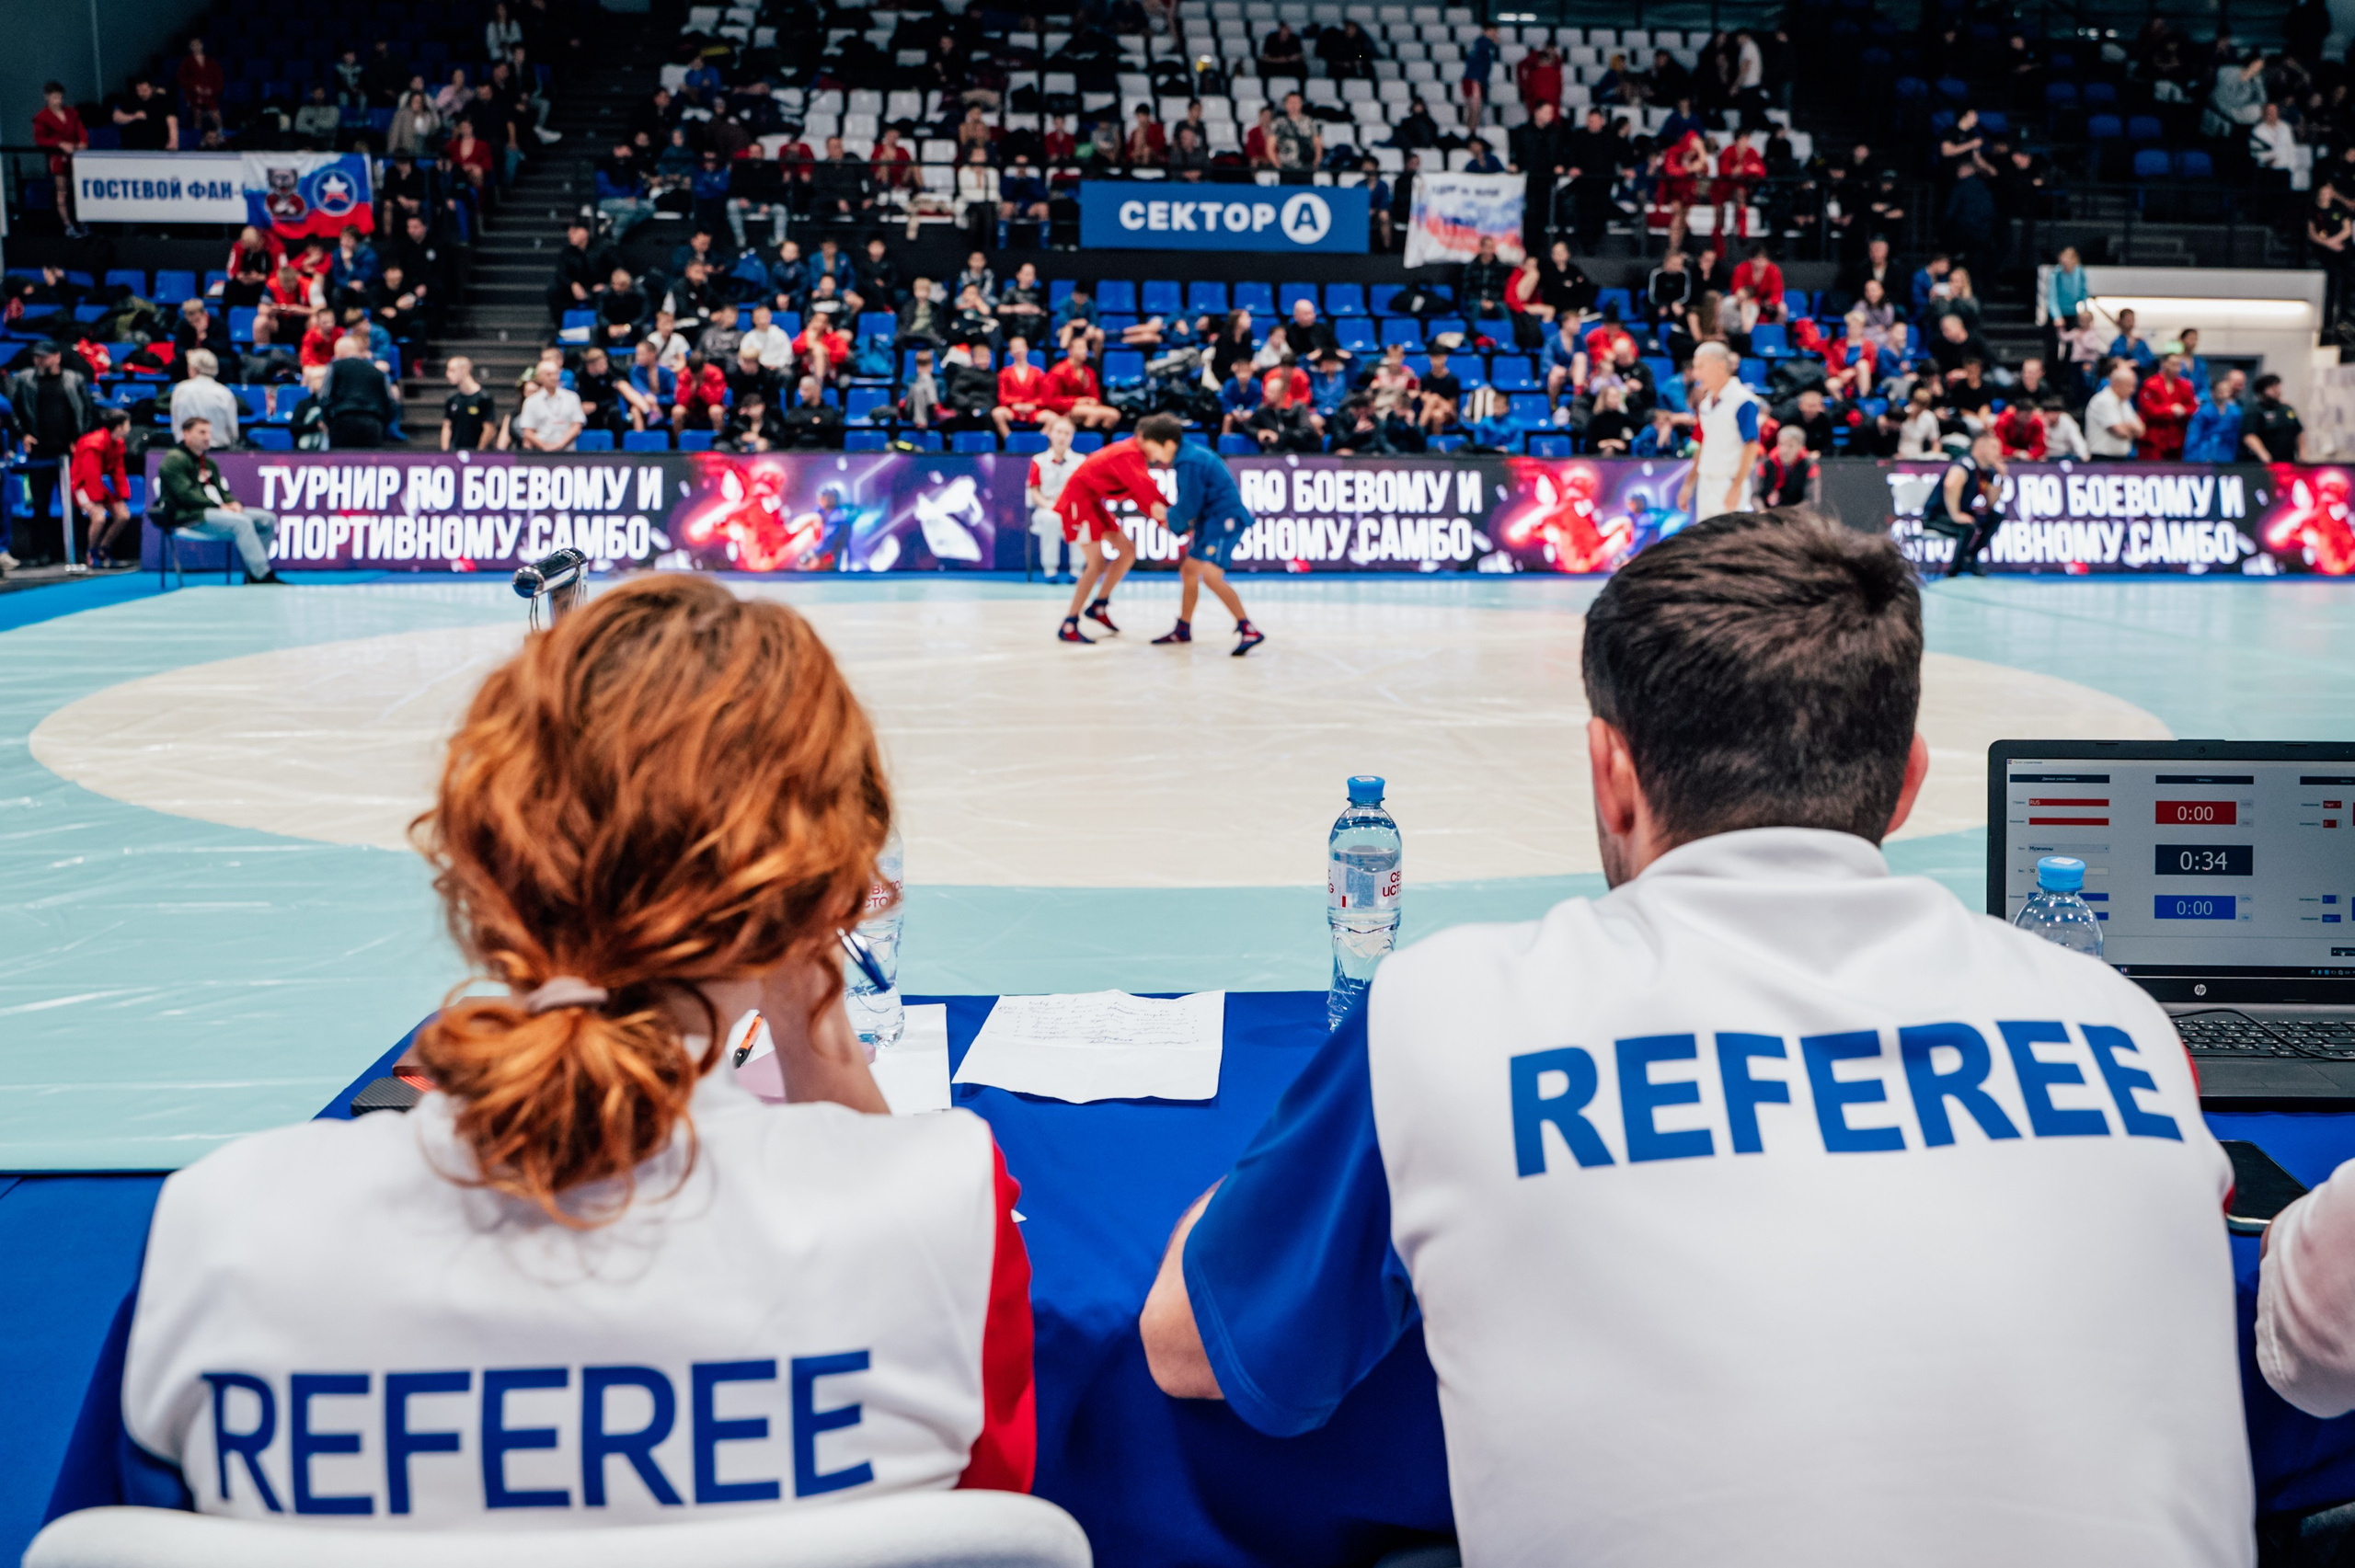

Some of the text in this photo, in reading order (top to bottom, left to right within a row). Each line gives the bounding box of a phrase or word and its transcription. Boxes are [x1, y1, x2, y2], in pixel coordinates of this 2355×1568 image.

[82, 176, 182, 200] ГОСТЕВОЙ
[1119, 200, 1276, 233] СЕКТОР
[258, 465, 664, 511] ТУРНИР ПО БОЕВОМУ И
[1239, 469, 1482, 515] ПО БОЕВОМУ И
[2017, 474, 2064, 518] ПО
[2066, 475, 2214, 518] БОЕВОМУ
[2218, 475, 2246, 519] И
[527, 516, 651, 561] САМБО
[1356, 518, 1473, 563] САМБО
[2127, 521, 2239, 565] САМБО
[2177, 806, 2214, 821] 0:00
[2179, 851, 2228, 871] 0:34
[2177, 900, 2213, 916] 0:00
[2195, 984, 2206, 996] hp
[1510, 1020, 2184, 1178] REFEREE
[199, 1349, 875, 1516] REFEREE
